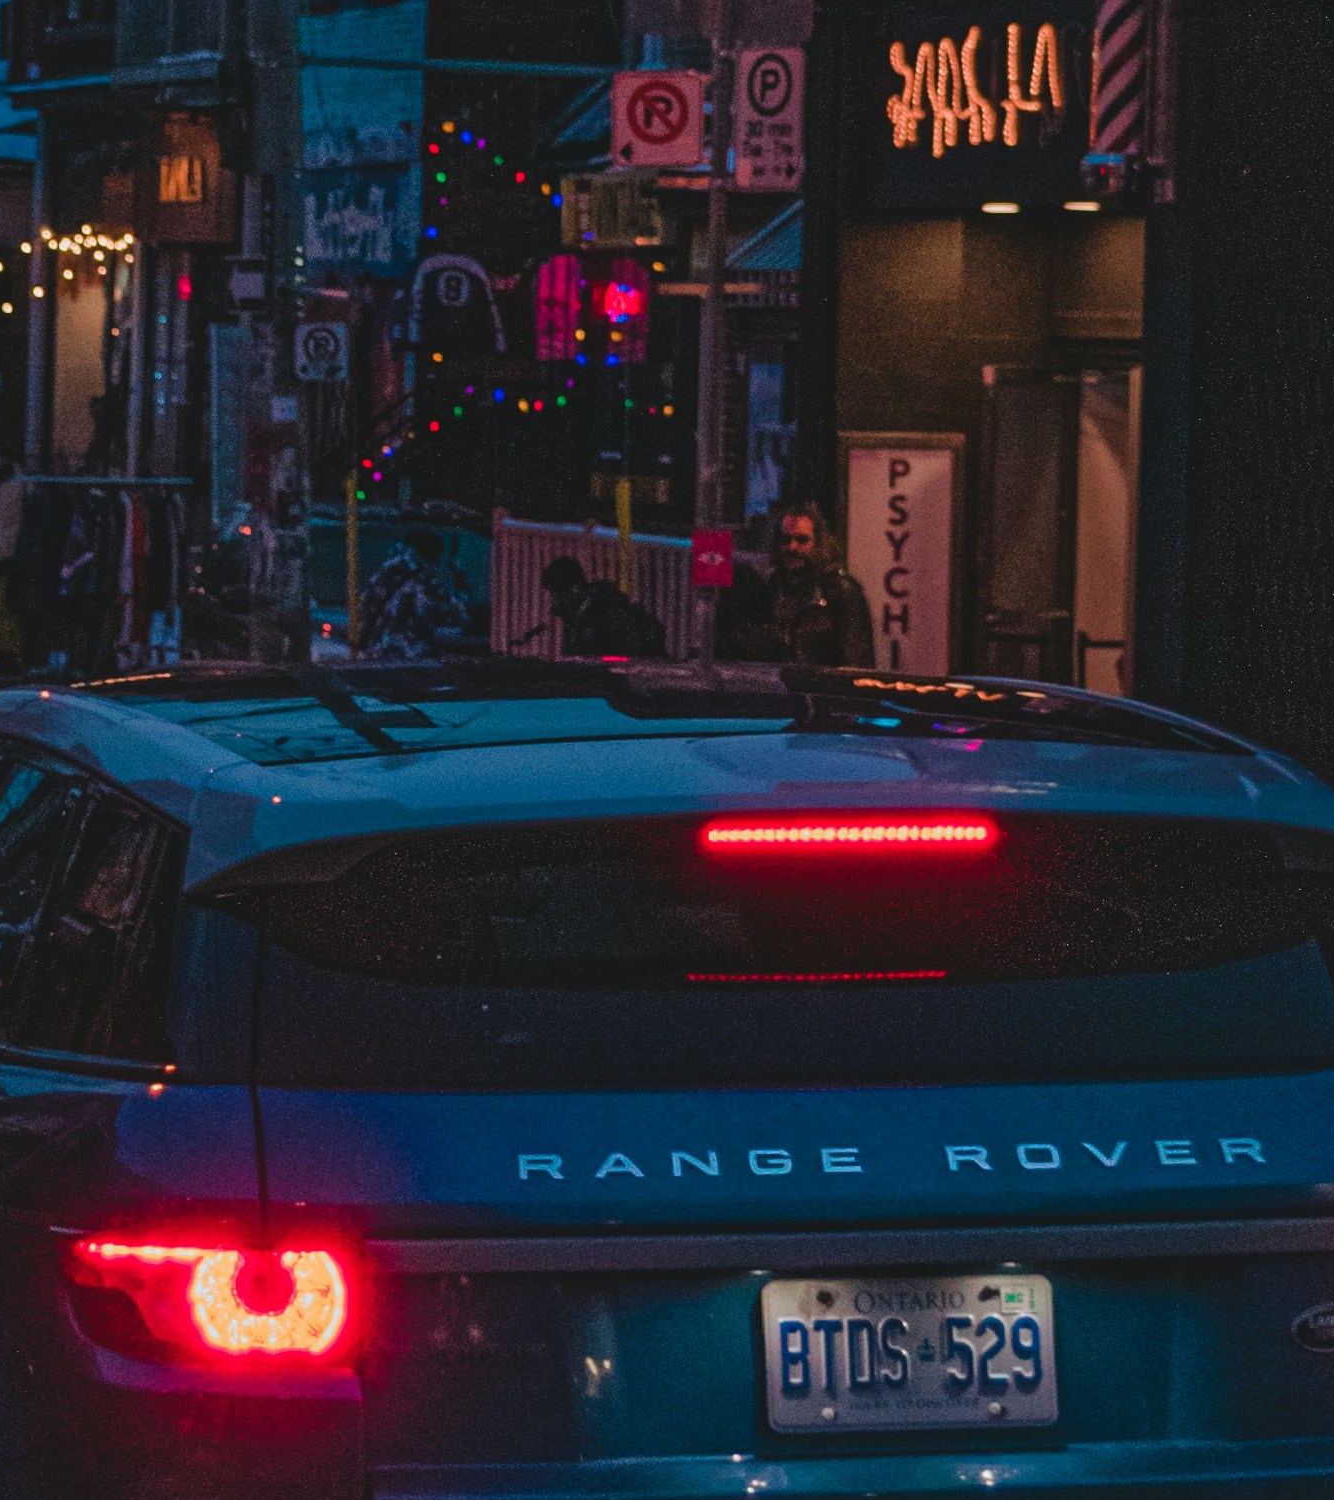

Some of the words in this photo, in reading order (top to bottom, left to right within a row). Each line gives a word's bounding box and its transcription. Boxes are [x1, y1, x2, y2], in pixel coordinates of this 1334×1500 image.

[517, 1145, 865, 1183] RANGE
[943, 1135, 1270, 1174] ROVER
[854, 1289, 966, 1314] ONTARIO
[778, 1315, 910, 1391] BTDS
[942, 1312, 1043, 1388] 529
